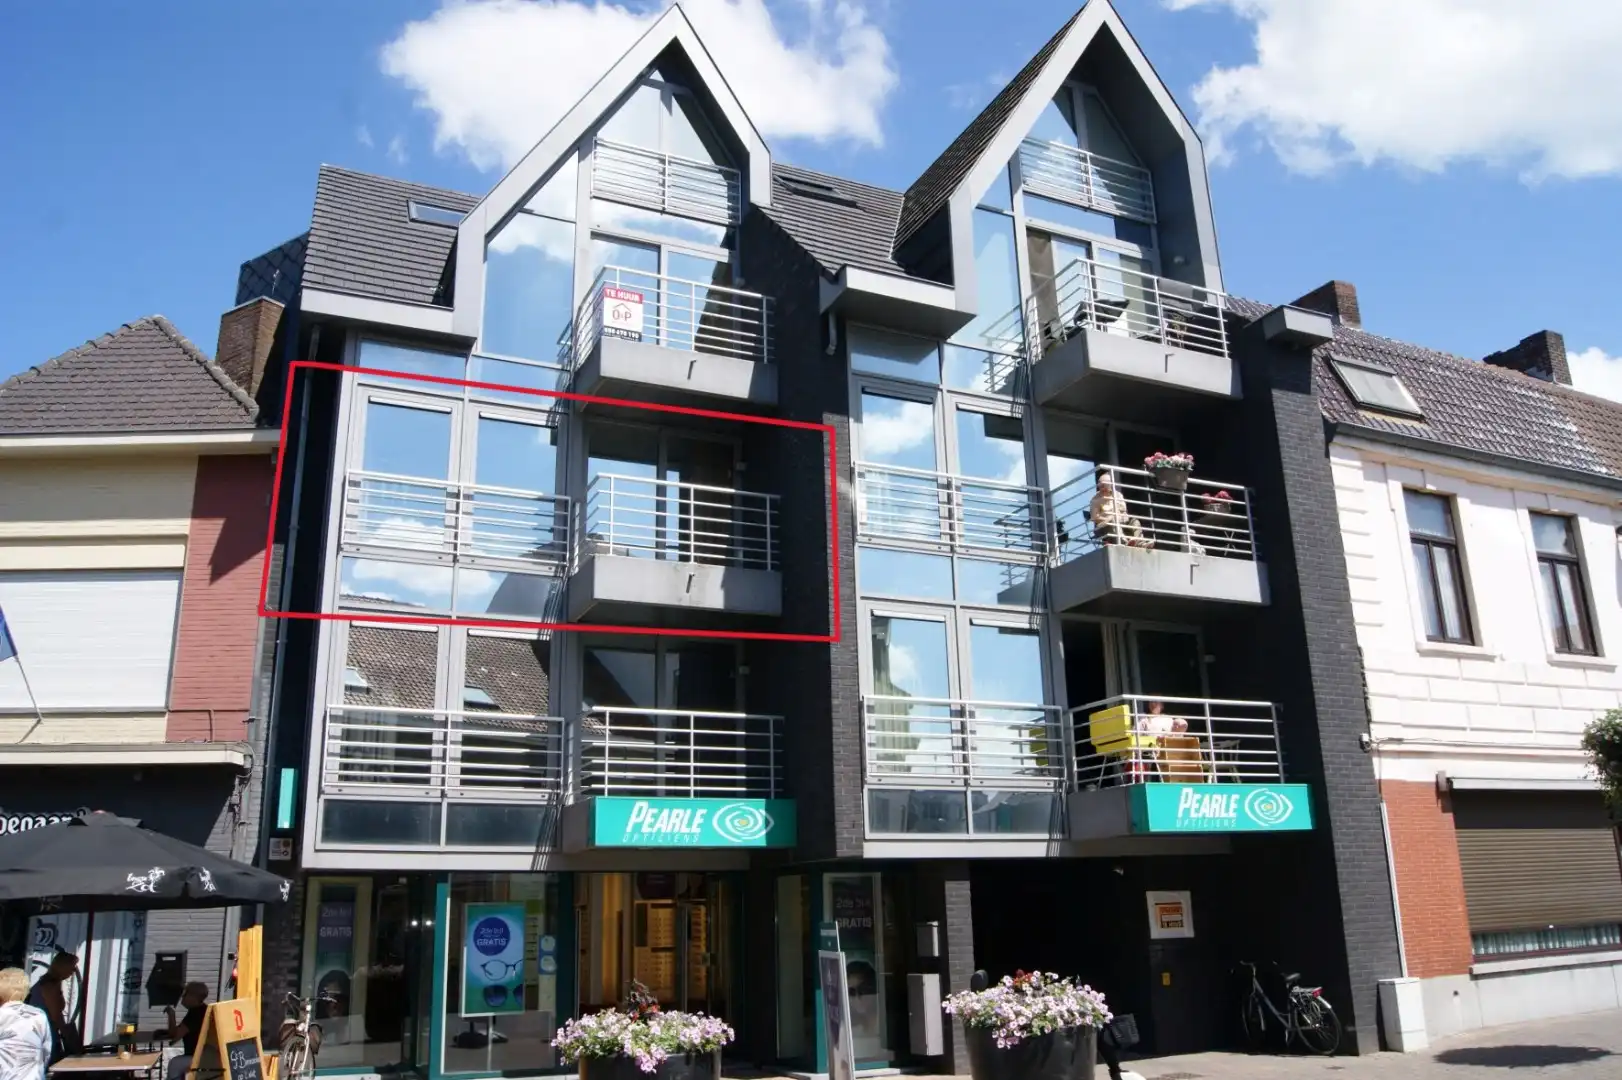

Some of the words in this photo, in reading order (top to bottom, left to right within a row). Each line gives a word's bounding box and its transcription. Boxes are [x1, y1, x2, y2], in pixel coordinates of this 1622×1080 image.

[606, 288, 616, 298] TE
[1177, 787, 1240, 818] PEARLE
[626, 800, 708, 833] PEARLE
[622, 833, 700, 844] OPTICIENS
[320, 926, 352, 938] GRATIS
[476, 938, 505, 946] GRATIS
